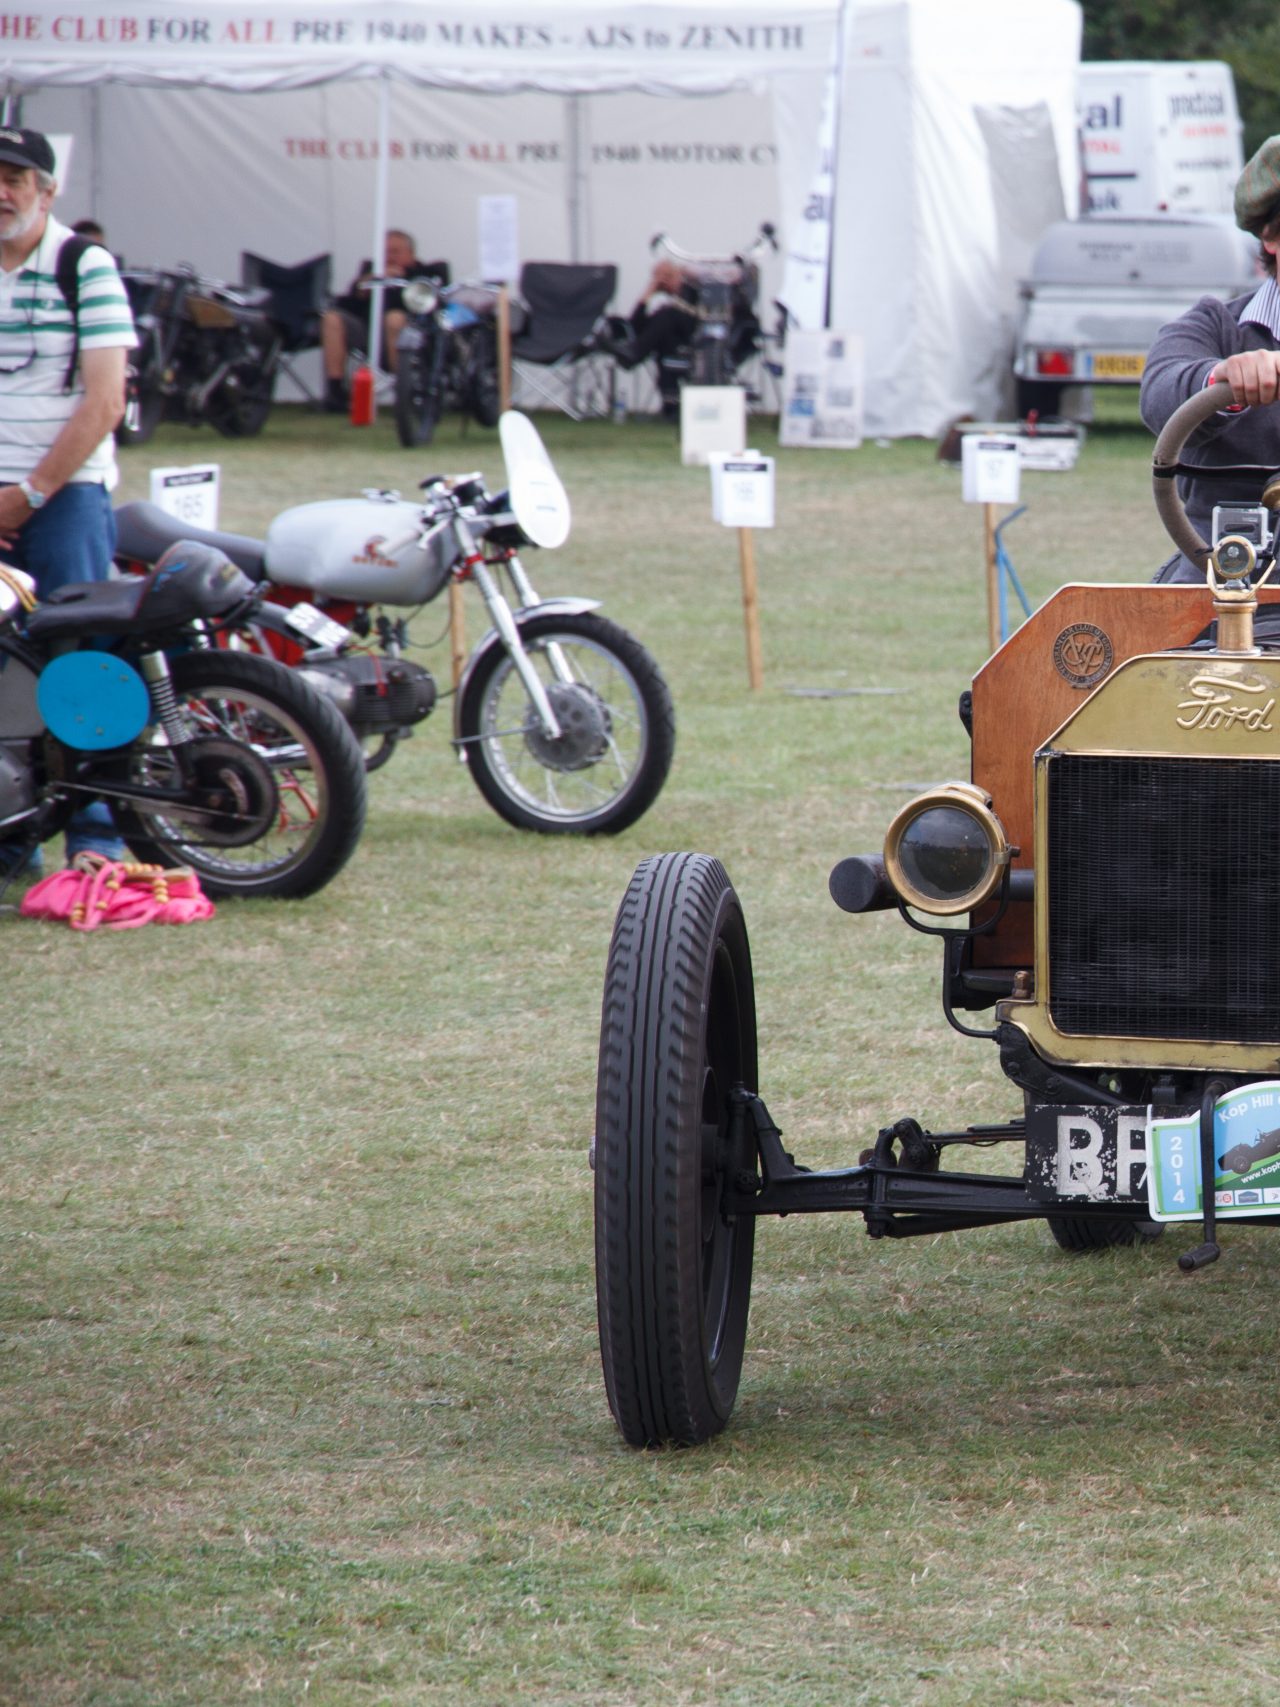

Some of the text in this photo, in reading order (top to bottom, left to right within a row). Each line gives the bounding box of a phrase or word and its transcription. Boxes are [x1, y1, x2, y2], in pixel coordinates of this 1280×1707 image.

[0, 15, 42, 42] HE
[51, 16, 138, 42] CLUB
[147, 18, 210, 43] FOR
[221, 20, 280, 43] ALL
[292, 20, 354, 44] PRE
[366, 21, 427, 46] 1940
[436, 23, 553, 49] MAKES
[583, 24, 636, 49] AJS
[644, 25, 671, 49] to
[679, 25, 804, 50] ZENITH
[284, 136, 330, 159] THE
[410, 139, 459, 161] FOR
[466, 141, 510, 162] ALL
[517, 141, 562, 163] PRE
[648, 143, 745, 165] MOTOR
[1176, 675, 1276, 732] Ford
[1218, 1102, 1249, 1123] Kop
[1251, 1093, 1273, 1109] Hill
[1169, 1135, 1186, 1204] 2014
